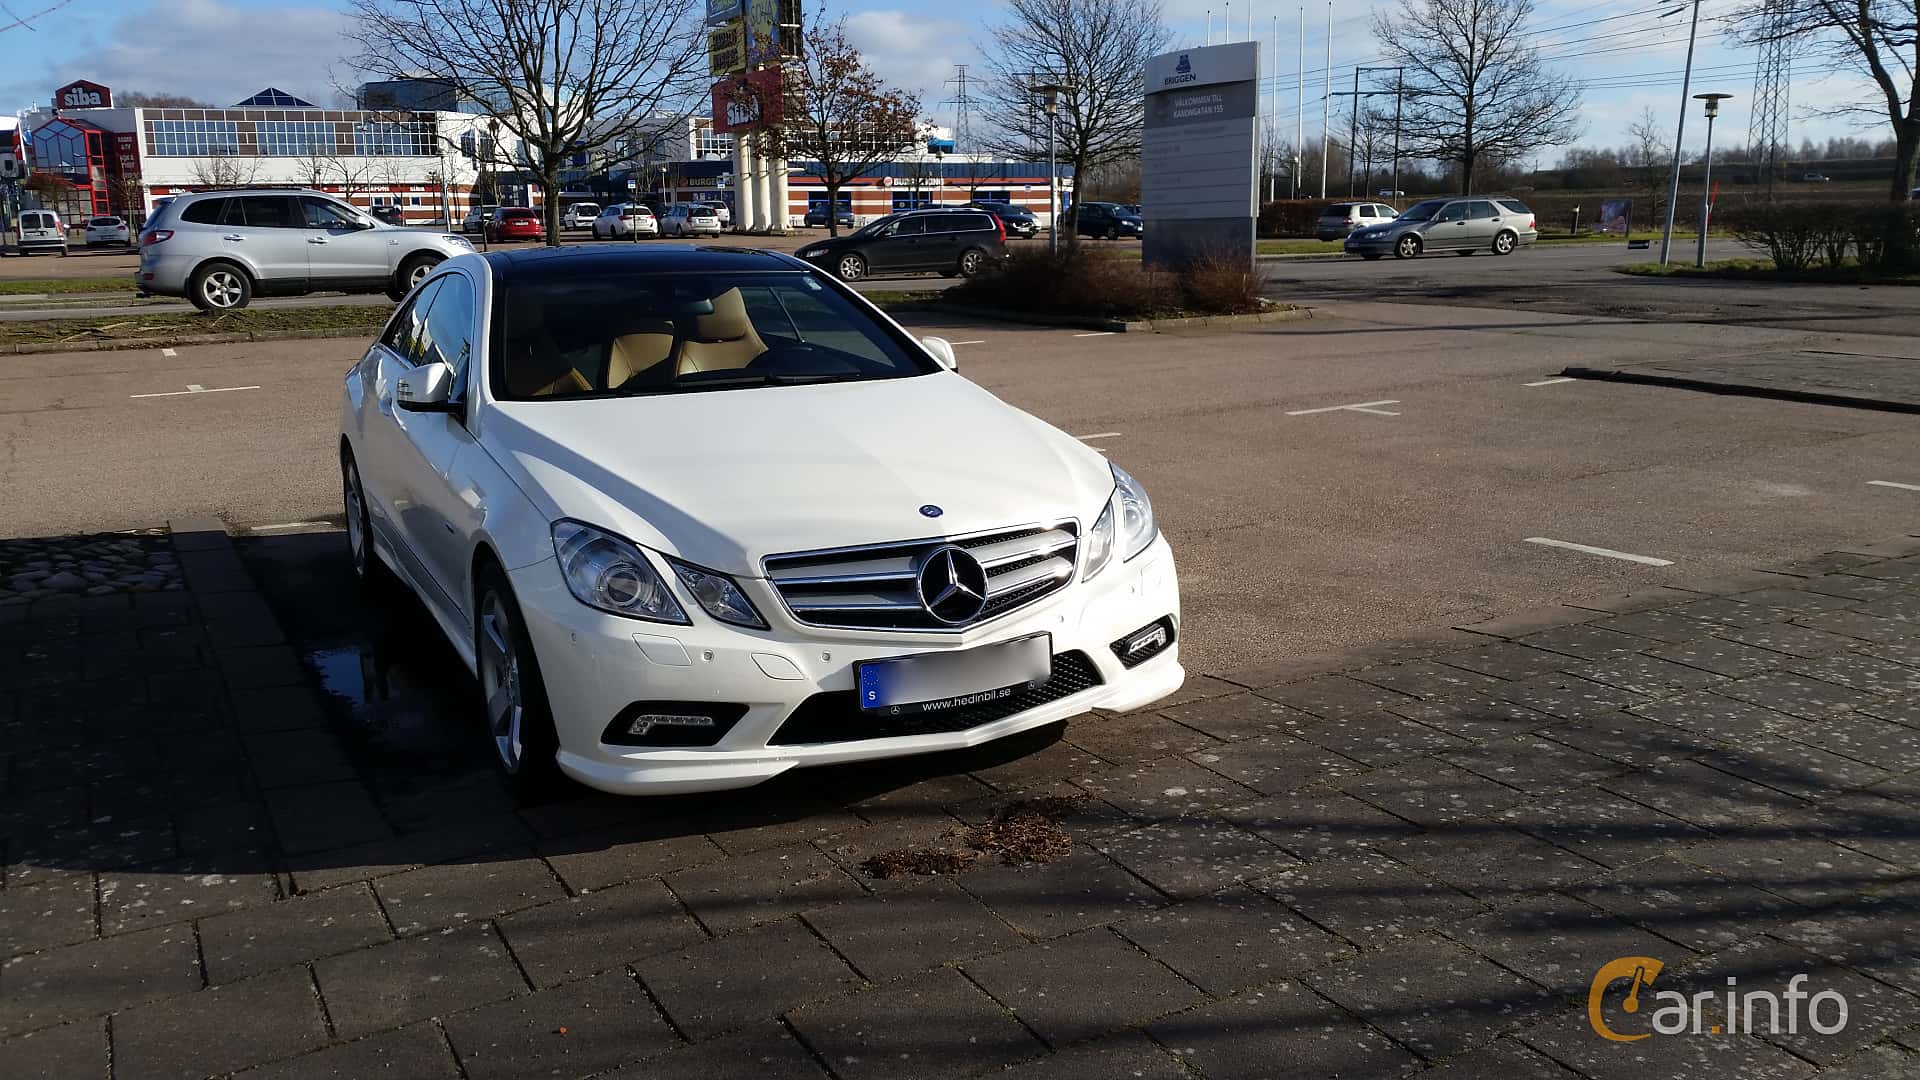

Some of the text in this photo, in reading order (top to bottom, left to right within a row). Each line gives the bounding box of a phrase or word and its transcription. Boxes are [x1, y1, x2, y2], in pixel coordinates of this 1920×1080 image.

[1165, 73, 1196, 85] BRIGGEN
[64, 88, 101, 106] siba
[690, 178, 722, 186] BURGE
[868, 690, 876, 701] S
[922, 688, 1011, 712] www.hedinbil.se
